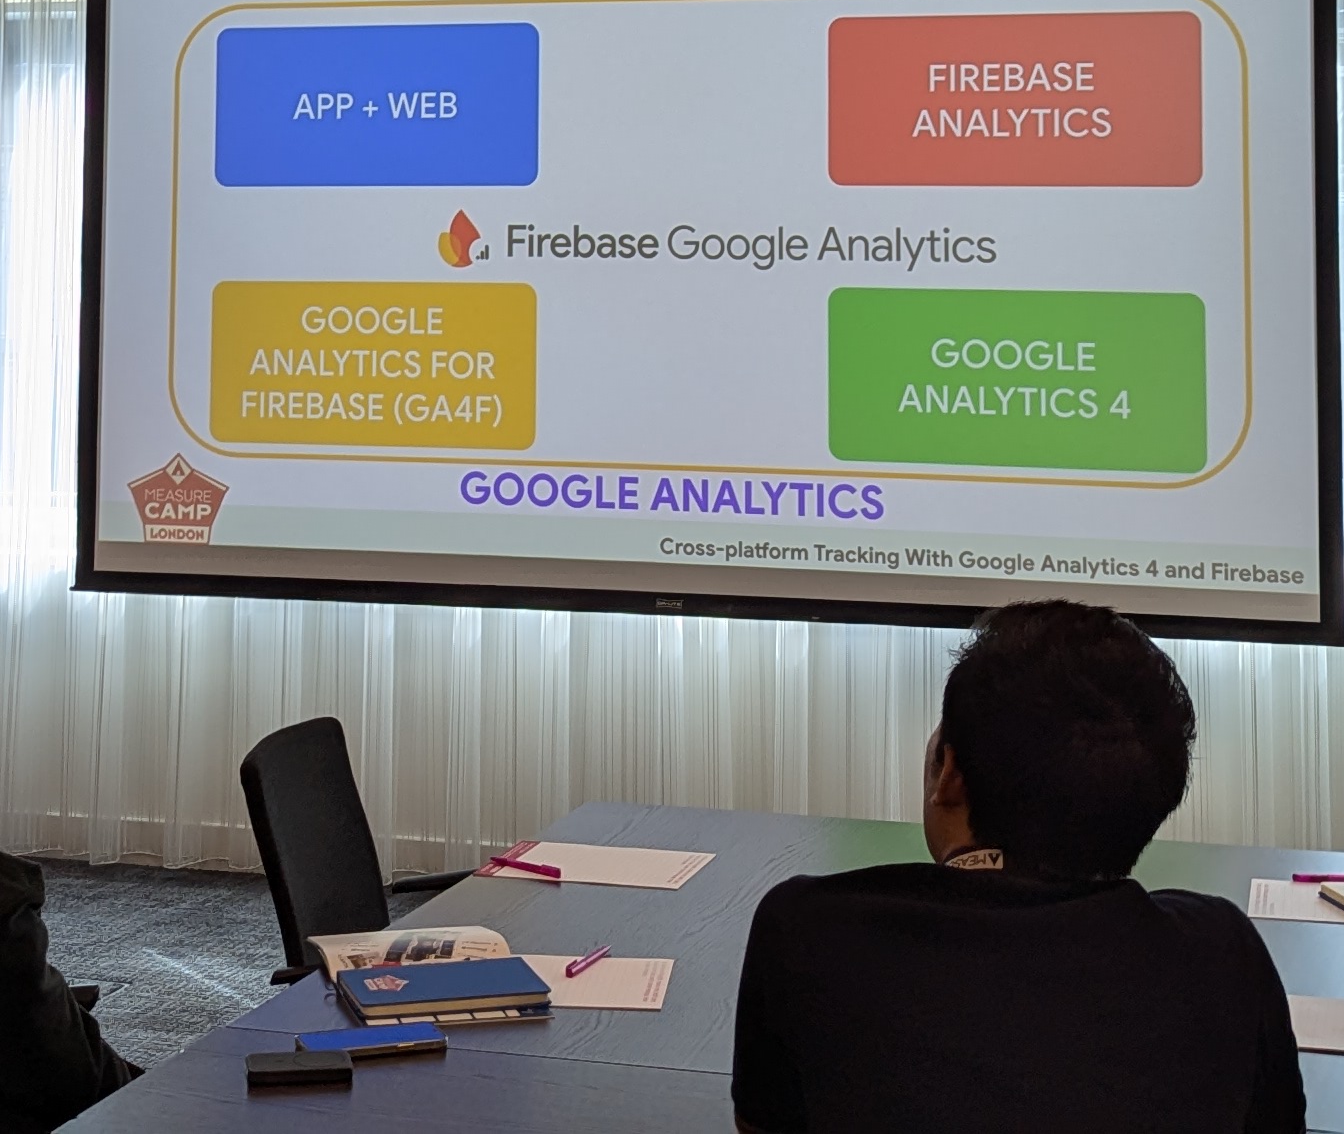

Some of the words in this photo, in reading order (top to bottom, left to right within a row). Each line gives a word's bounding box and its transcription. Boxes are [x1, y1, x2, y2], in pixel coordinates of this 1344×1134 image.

[928, 62, 1095, 92] FIREBASE
[293, 93, 354, 121] APP
[362, 100, 378, 117] +
[388, 92, 458, 120] WEB
[912, 107, 1112, 137] ANALYTICS
[506, 224, 659, 259] Firebase
[667, 224, 808, 270] Google
[817, 226, 997, 272] Analytics
[301, 306, 443, 335] GOOGLE
[249, 349, 421, 378] ANALYTICS
[431, 351, 495, 379] FOR
[931, 338, 1096, 371] GOOGLE
[241, 391, 384, 420] FIREBASE
[394, 392, 502, 428] (GA4F)
[898, 384, 1099, 418] ANALYTICS
[1109, 390, 1131, 419] 4
[144, 488, 212, 503] MEASURE
[460, 471, 639, 510] GOOGLE
[650, 477, 885, 520] ANALYTICS
[144, 502, 212, 520] CAMP
[150, 527, 204, 540] LONDON
[659, 537, 808, 561] Cross-platform
[813, 544, 900, 569] Tracking
[905, 547, 953, 568] With
[958, 550, 1035, 575] Google
[1041, 554, 1140, 579] Analytics
[1145, 559, 1158, 577] 4
[1165, 561, 1205, 580] and
[1211, 562, 1305, 584] Firebase
